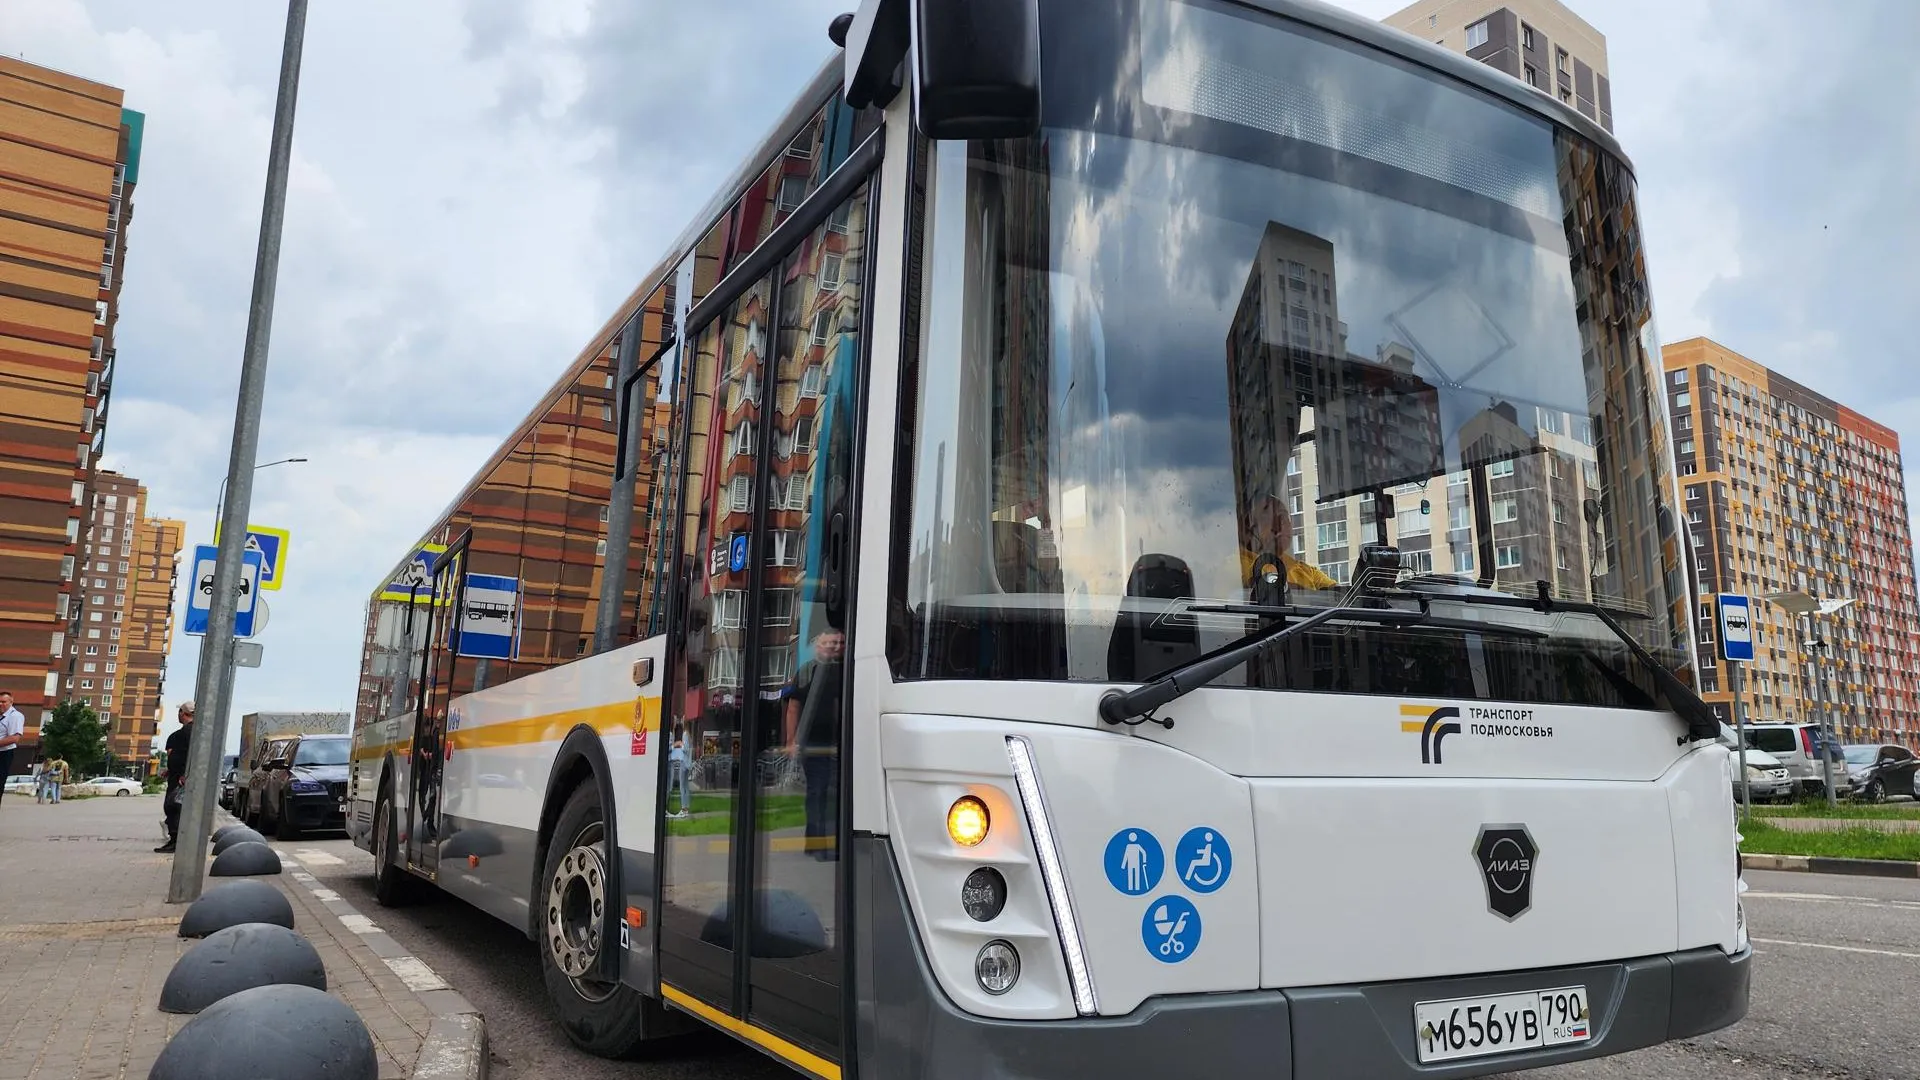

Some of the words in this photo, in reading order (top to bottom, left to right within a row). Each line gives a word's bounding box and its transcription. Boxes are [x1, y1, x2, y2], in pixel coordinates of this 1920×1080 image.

[1469, 707, 1534, 721] ТРАНСПОРТ
[1470, 723, 1553, 738] ПОДМОСКОВЬЯ
[1541, 993, 1581, 1026] 790
[1553, 1026, 1573, 1038] RUS
